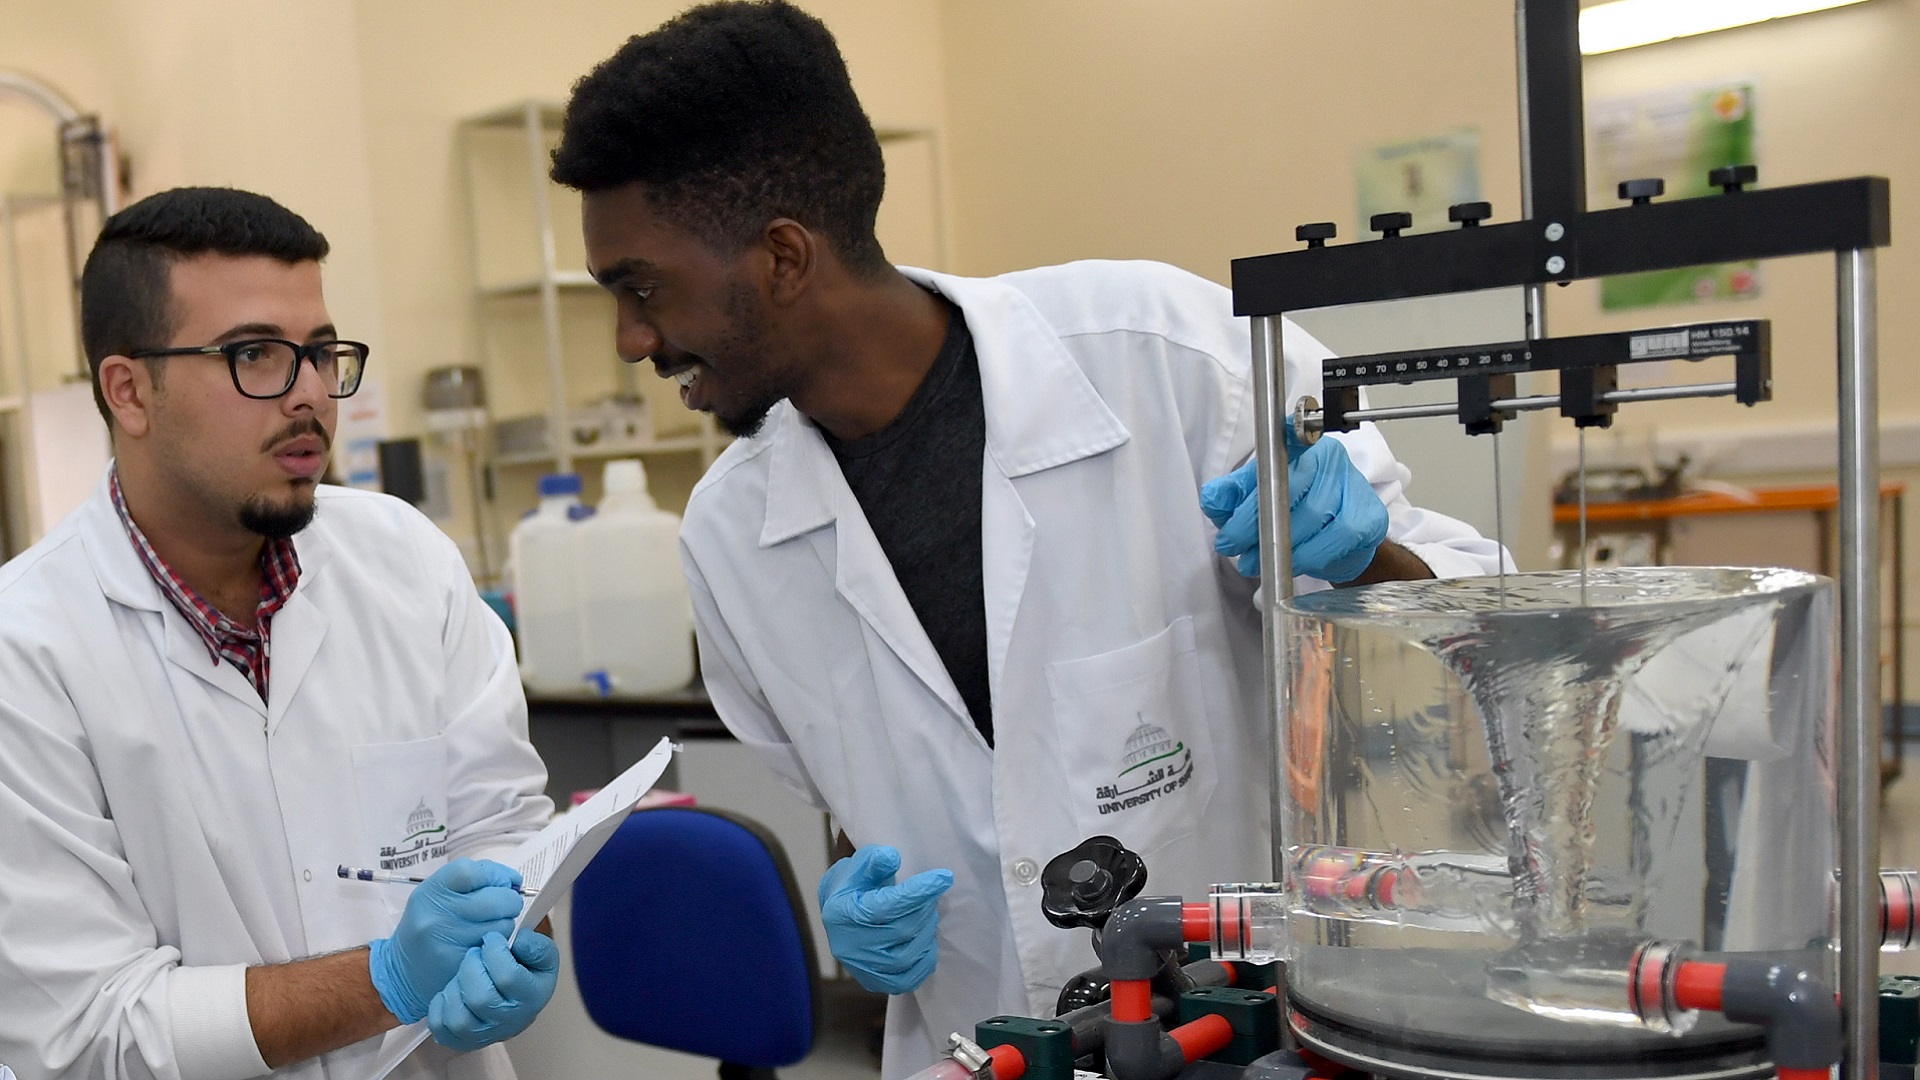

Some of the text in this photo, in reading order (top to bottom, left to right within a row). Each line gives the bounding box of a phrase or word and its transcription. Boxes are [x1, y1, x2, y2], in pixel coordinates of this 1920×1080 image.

[1335, 368, 1347, 377] 90
[1355, 366, 1367, 375] 80
[1376, 364, 1387, 373] 70
[1396, 363, 1408, 371] 60
[1416, 361, 1428, 370] 50
[1436, 359, 1449, 368] 40
[1458, 357, 1470, 366] 30
[1479, 355, 1491, 364] 20
[1501, 353, 1513, 362] 10
[1524, 351, 1532, 360] 0
[1098, 780, 1178, 815] UNIVERSITY OF
[380, 853, 419, 870] UNIVERSITY
[422, 850, 429, 862] OF
